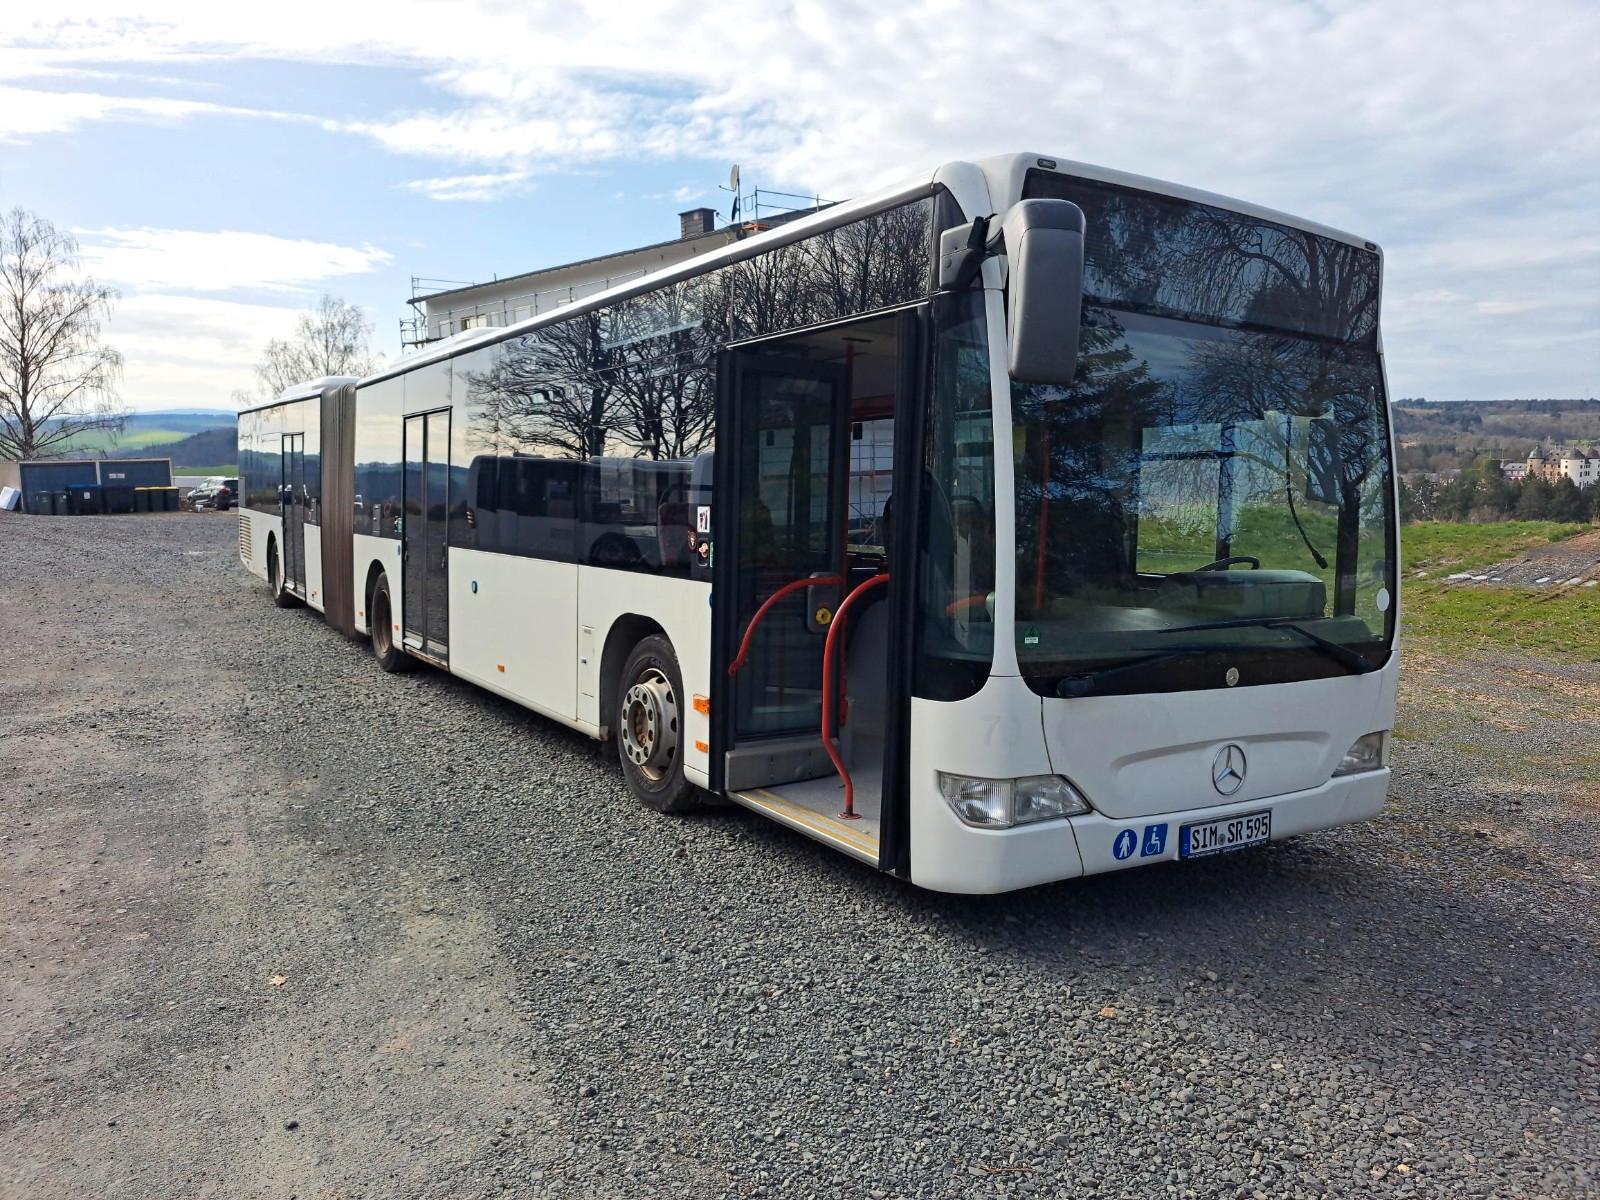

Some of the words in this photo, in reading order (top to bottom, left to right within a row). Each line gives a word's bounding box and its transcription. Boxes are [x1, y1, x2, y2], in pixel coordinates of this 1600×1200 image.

[1192, 825, 1217, 849] SIM
[1227, 821, 1243, 843] SR
[1246, 816, 1268, 839] 595
